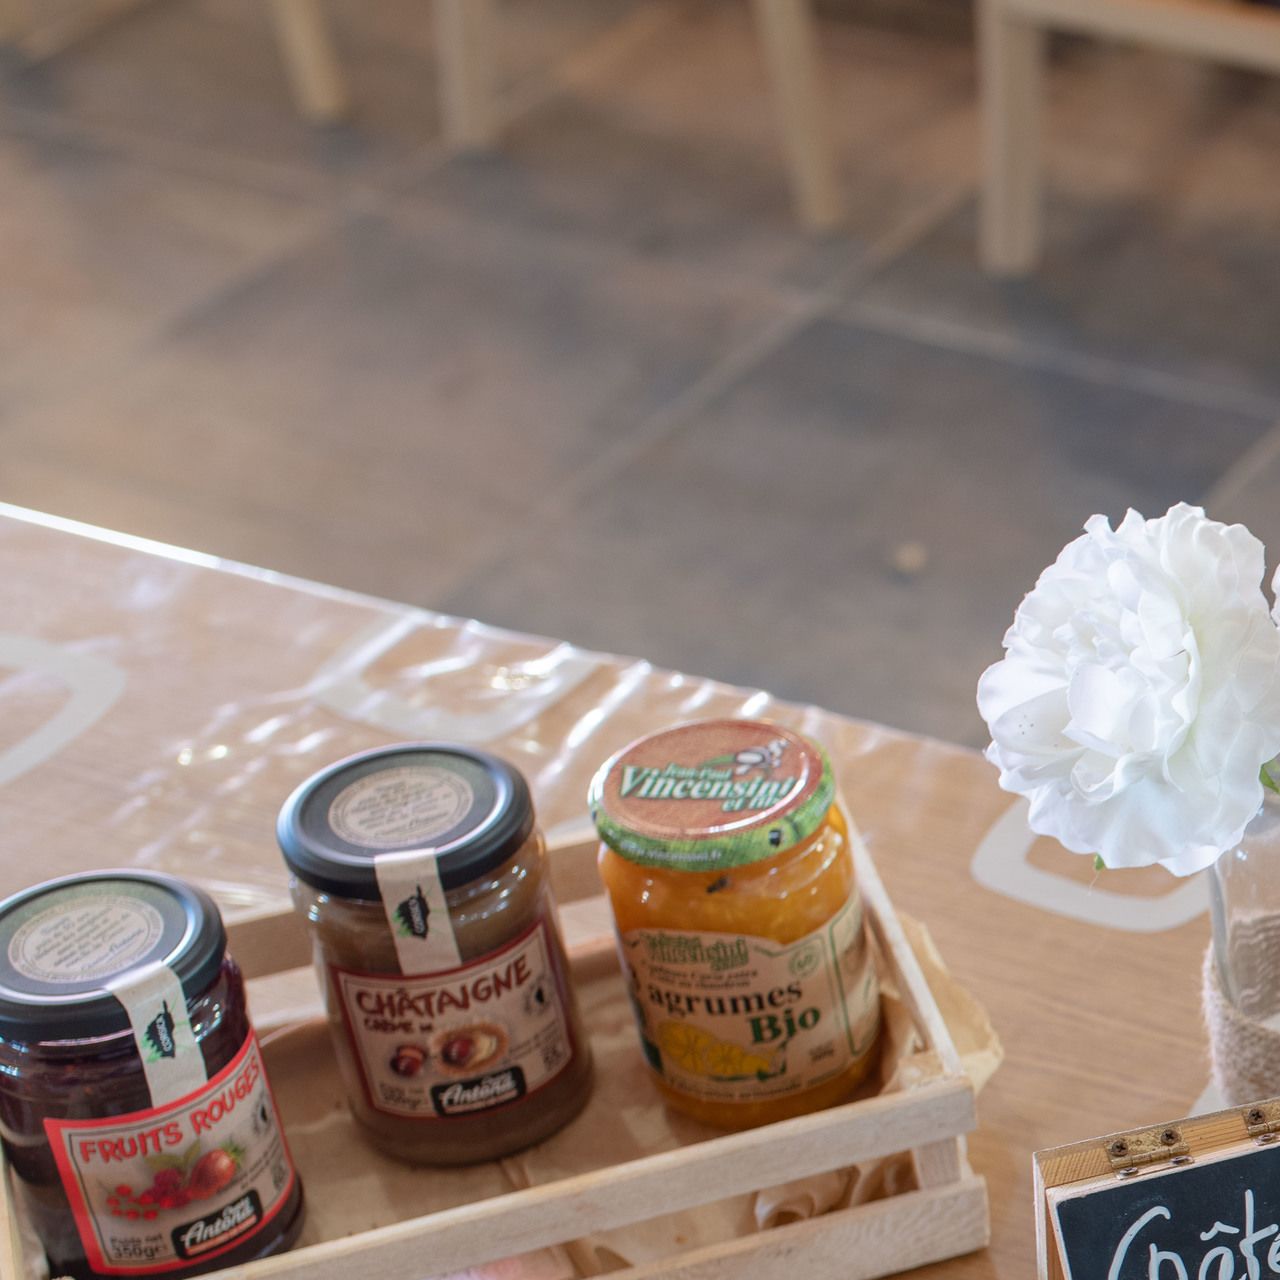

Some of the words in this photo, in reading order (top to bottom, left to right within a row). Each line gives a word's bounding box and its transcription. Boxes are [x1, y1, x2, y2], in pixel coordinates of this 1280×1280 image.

[620, 765, 796, 800] Vincensini
[356, 955, 532, 1019] CHÂTAIGNE
[647, 980, 804, 1018] agrumes
[750, 1006, 821, 1044] Bio
[79, 1122, 184, 1164] FRUITS
[190, 1055, 261, 1135] ROUGES
